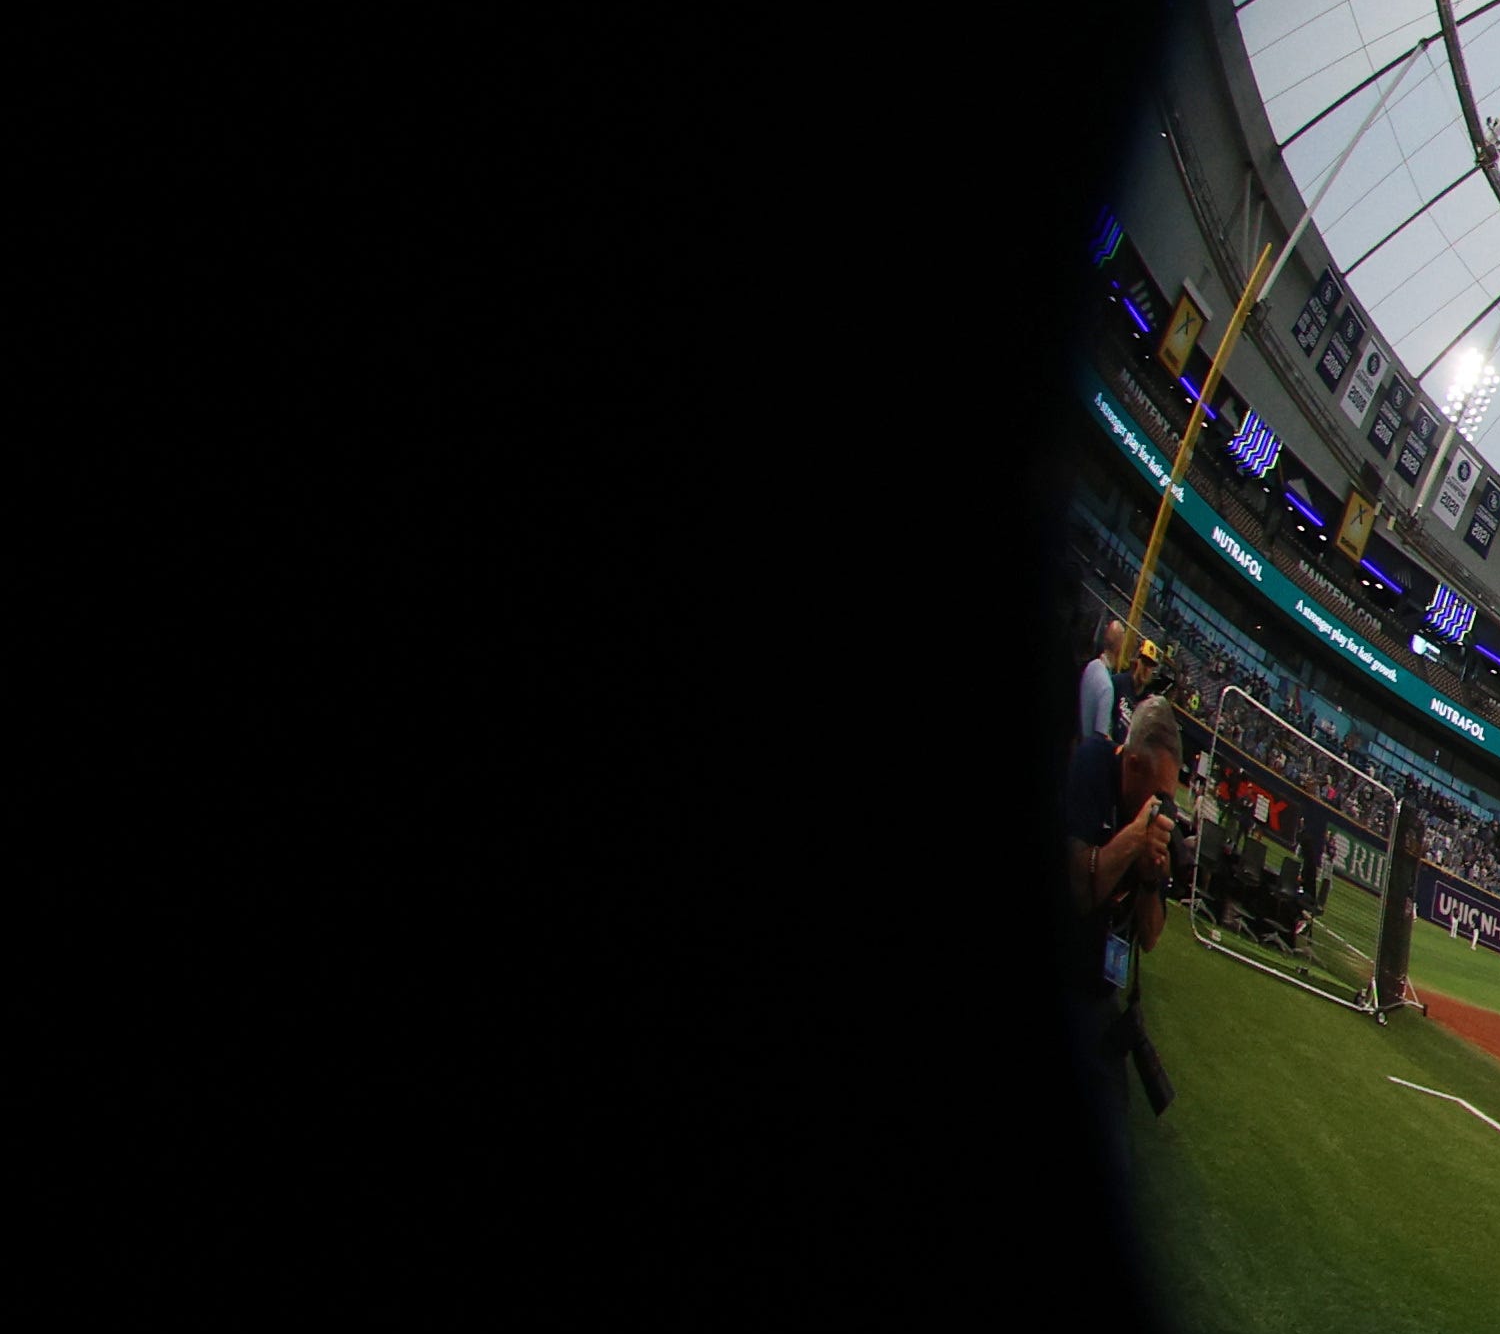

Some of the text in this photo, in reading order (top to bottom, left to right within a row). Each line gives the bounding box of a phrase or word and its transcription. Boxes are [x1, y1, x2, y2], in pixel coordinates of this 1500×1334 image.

[1211, 525, 1263, 583] NUTRAFOL
[1471, 523, 1491, 546] 2021
[1295, 599, 1303, 612] A
[1302, 606, 1333, 635] stronger
[1330, 628, 1349, 648] play
[1346, 637, 1361, 655] for
[1356, 646, 1374, 667] hair
[1430, 697, 1486, 742] NUTRAFOL
